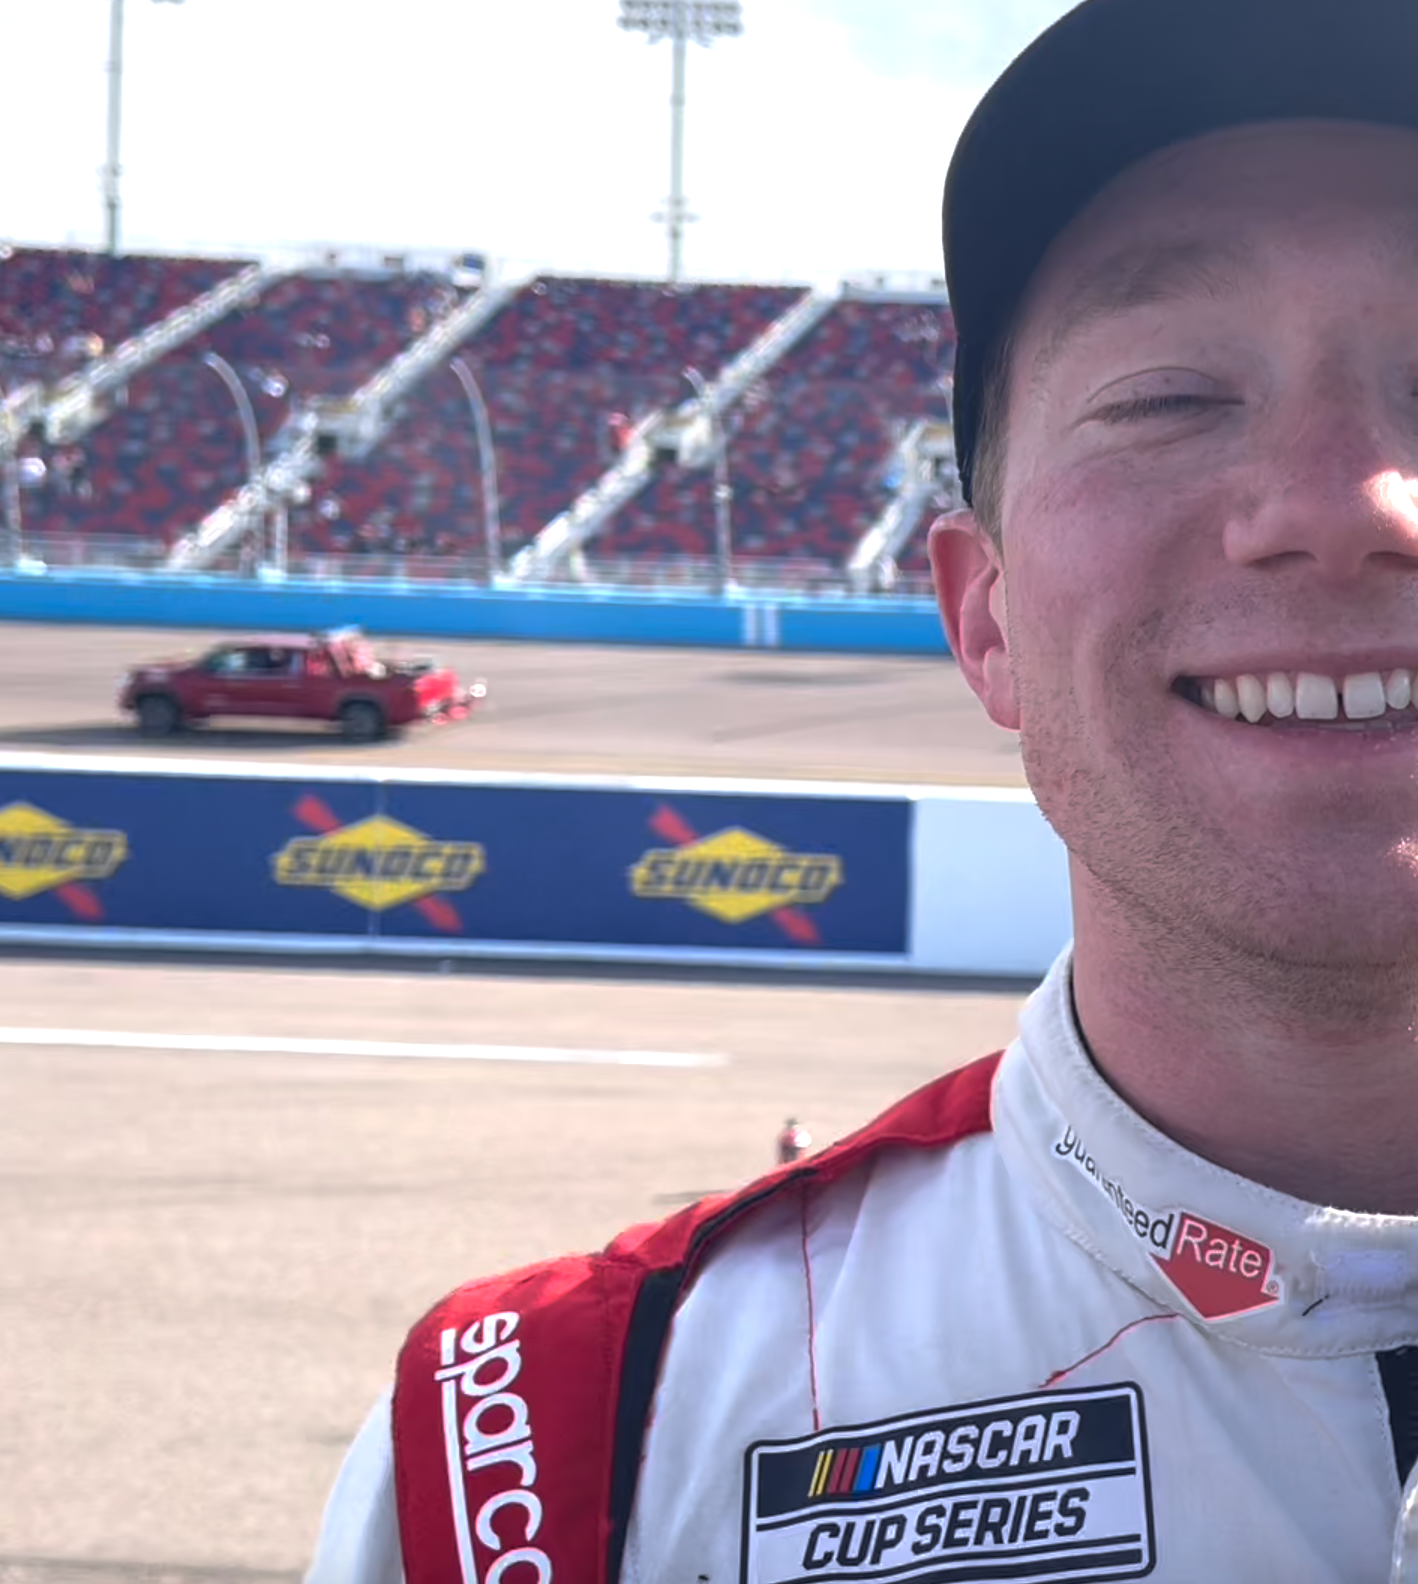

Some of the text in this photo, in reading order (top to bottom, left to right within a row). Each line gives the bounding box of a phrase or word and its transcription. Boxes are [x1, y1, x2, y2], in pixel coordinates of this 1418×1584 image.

[285, 845, 476, 880] SUNOCO
[642, 857, 832, 894] SUNOCO
[1176, 1218, 1262, 1278] Rate
[434, 1311, 553, 1584] sparco
[874, 1410, 1081, 1491] NASCAR
[802, 1486, 1091, 1571] CUP SERIES
